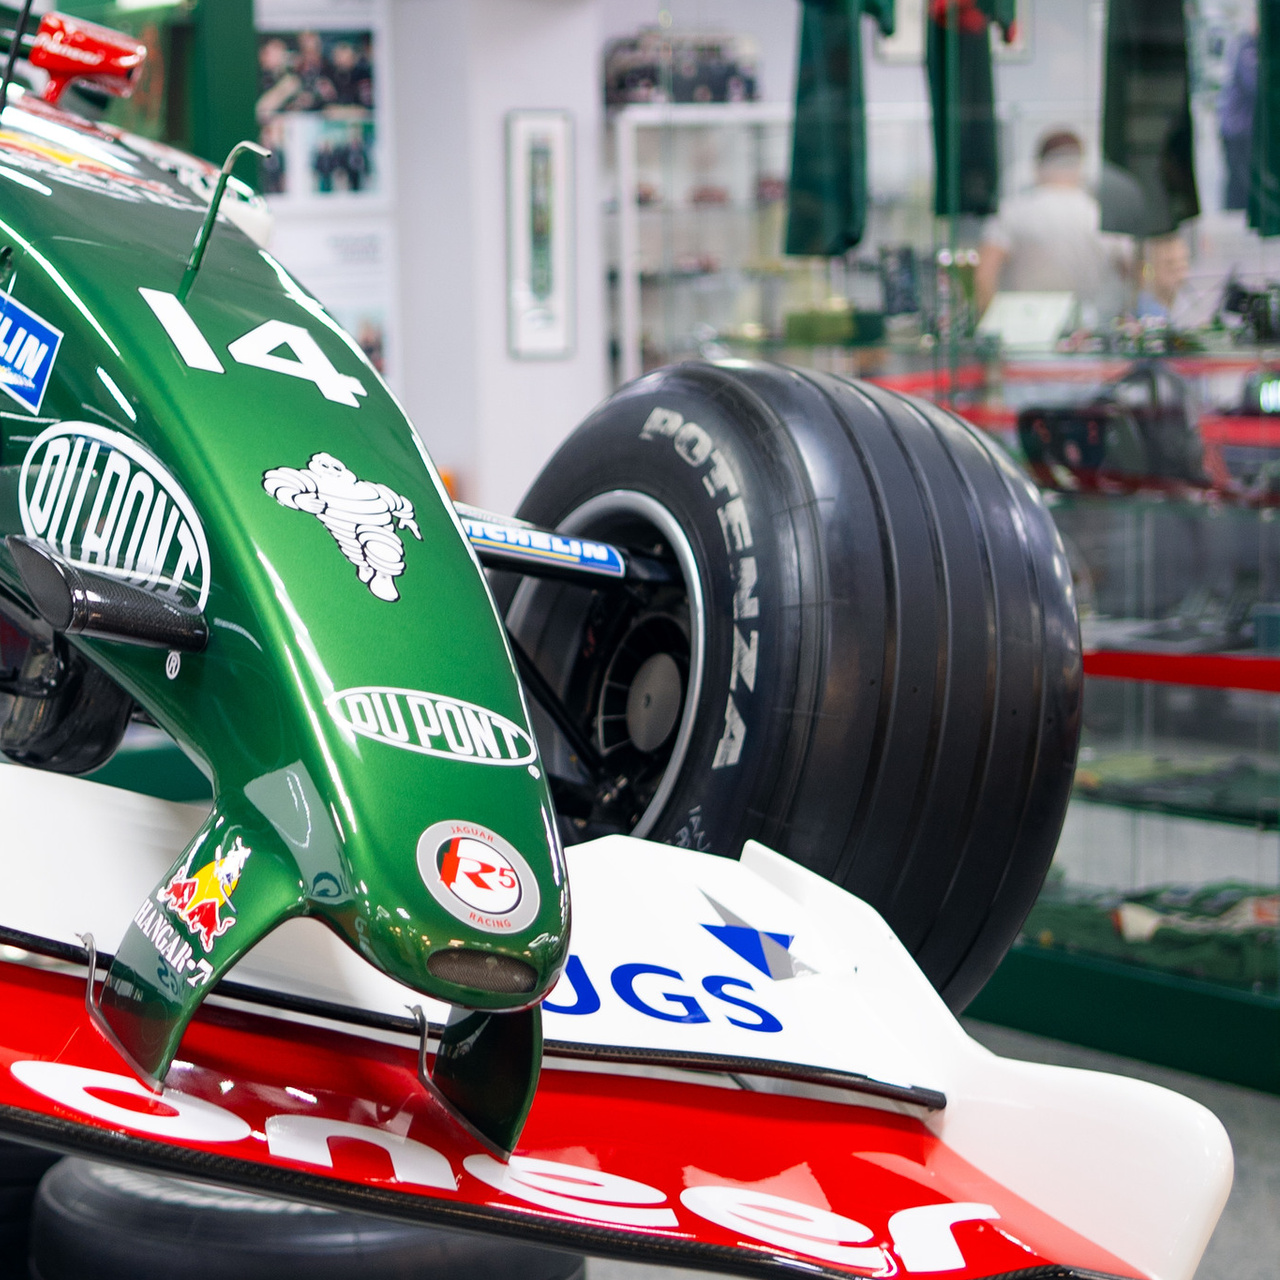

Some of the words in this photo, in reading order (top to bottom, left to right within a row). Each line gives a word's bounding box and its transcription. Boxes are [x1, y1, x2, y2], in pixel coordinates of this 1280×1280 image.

[137, 286, 368, 409] 14
[639, 406, 760, 770] POTENZA
[451, 825, 495, 843] JAGUAR
[133, 898, 214, 988] HANGAR-7
[469, 911, 512, 929] RACING
